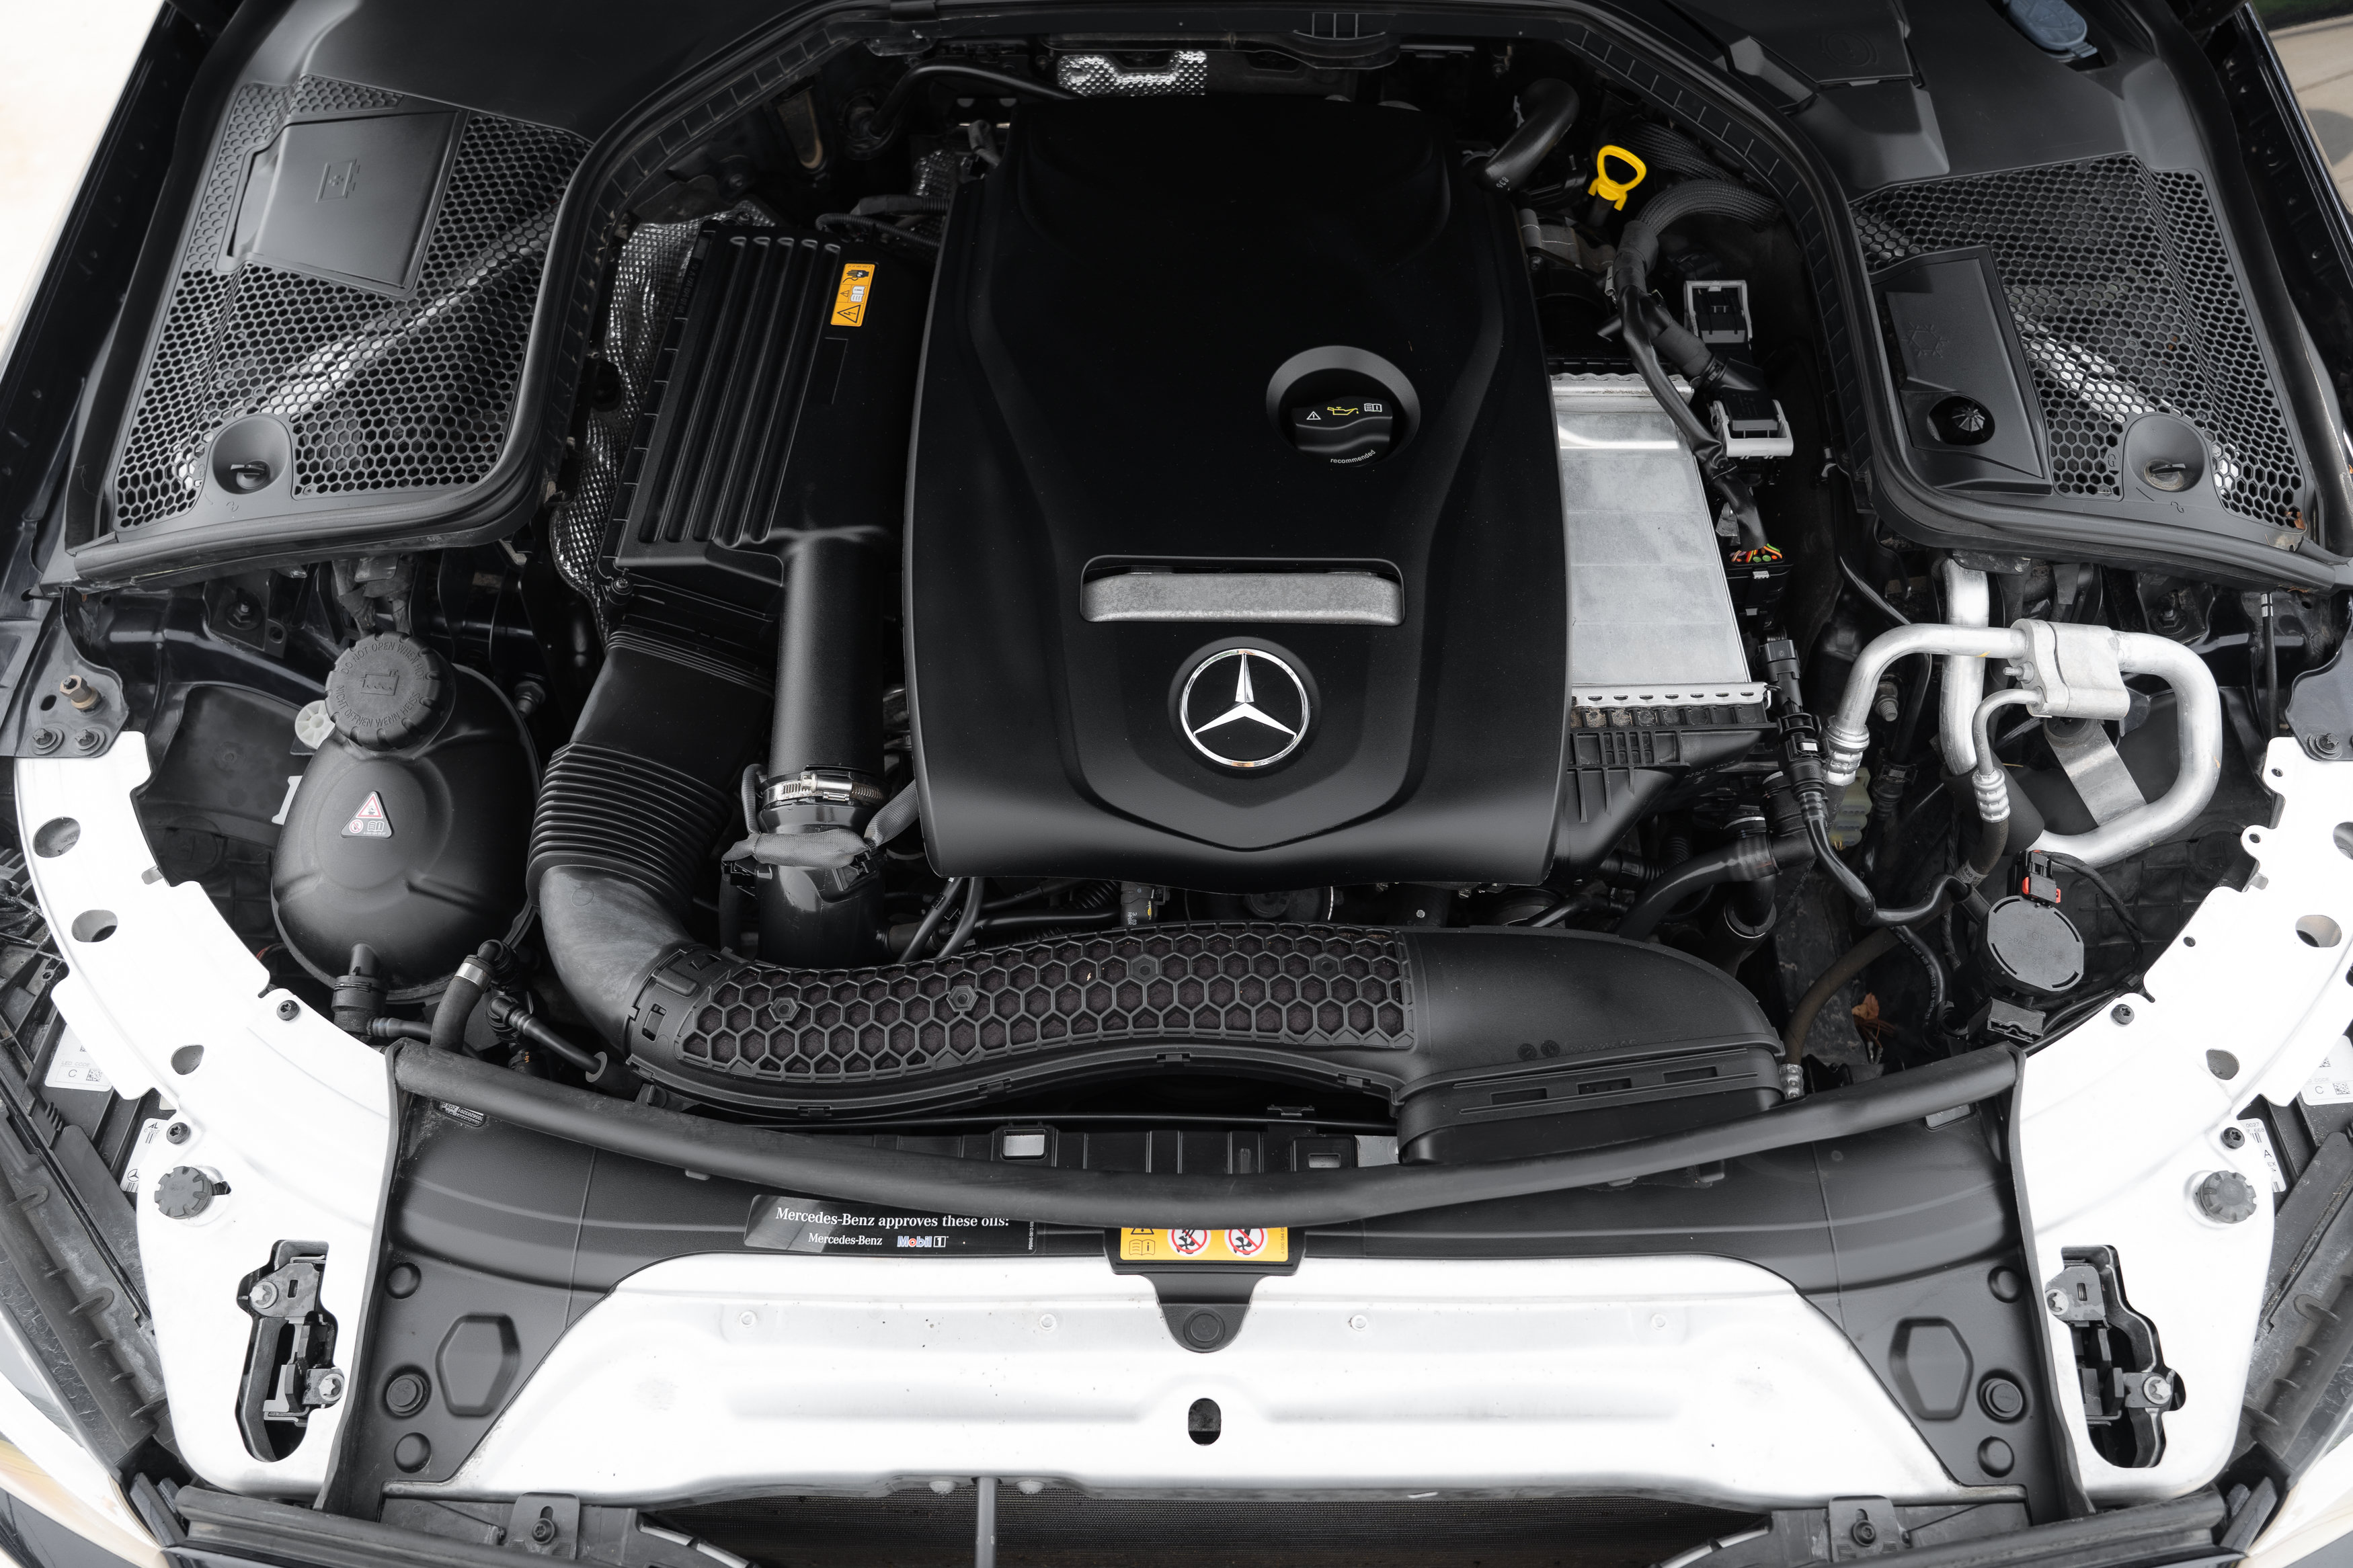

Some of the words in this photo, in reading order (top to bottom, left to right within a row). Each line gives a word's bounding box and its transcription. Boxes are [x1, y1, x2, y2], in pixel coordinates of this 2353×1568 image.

[1330, 449, 1376, 464] recommended
[341, 662, 354, 675] DO
[354, 647, 370, 663] NOT
[371, 642, 396, 652] OPEN
[397, 643, 420, 666] WHEN
[413, 662, 426, 681] HOT
[335, 684, 350, 710] NICHT
[375, 713, 401, 728] WENN
[399, 692, 421, 716] HEISS
[69, 1069, 77, 1077] C
[2315, 1085, 2324, 1094] C
[2264, 1149, 2272, 1159] A
[775, 1207, 875, 1226] Mercedes-Benz
[878, 1216, 938, 1229] approves
[942, 1215, 978, 1227] these
[808, 1233, 883, 1245] Mercedes-Benz
[897, 1235, 932, 1247] Mobil
